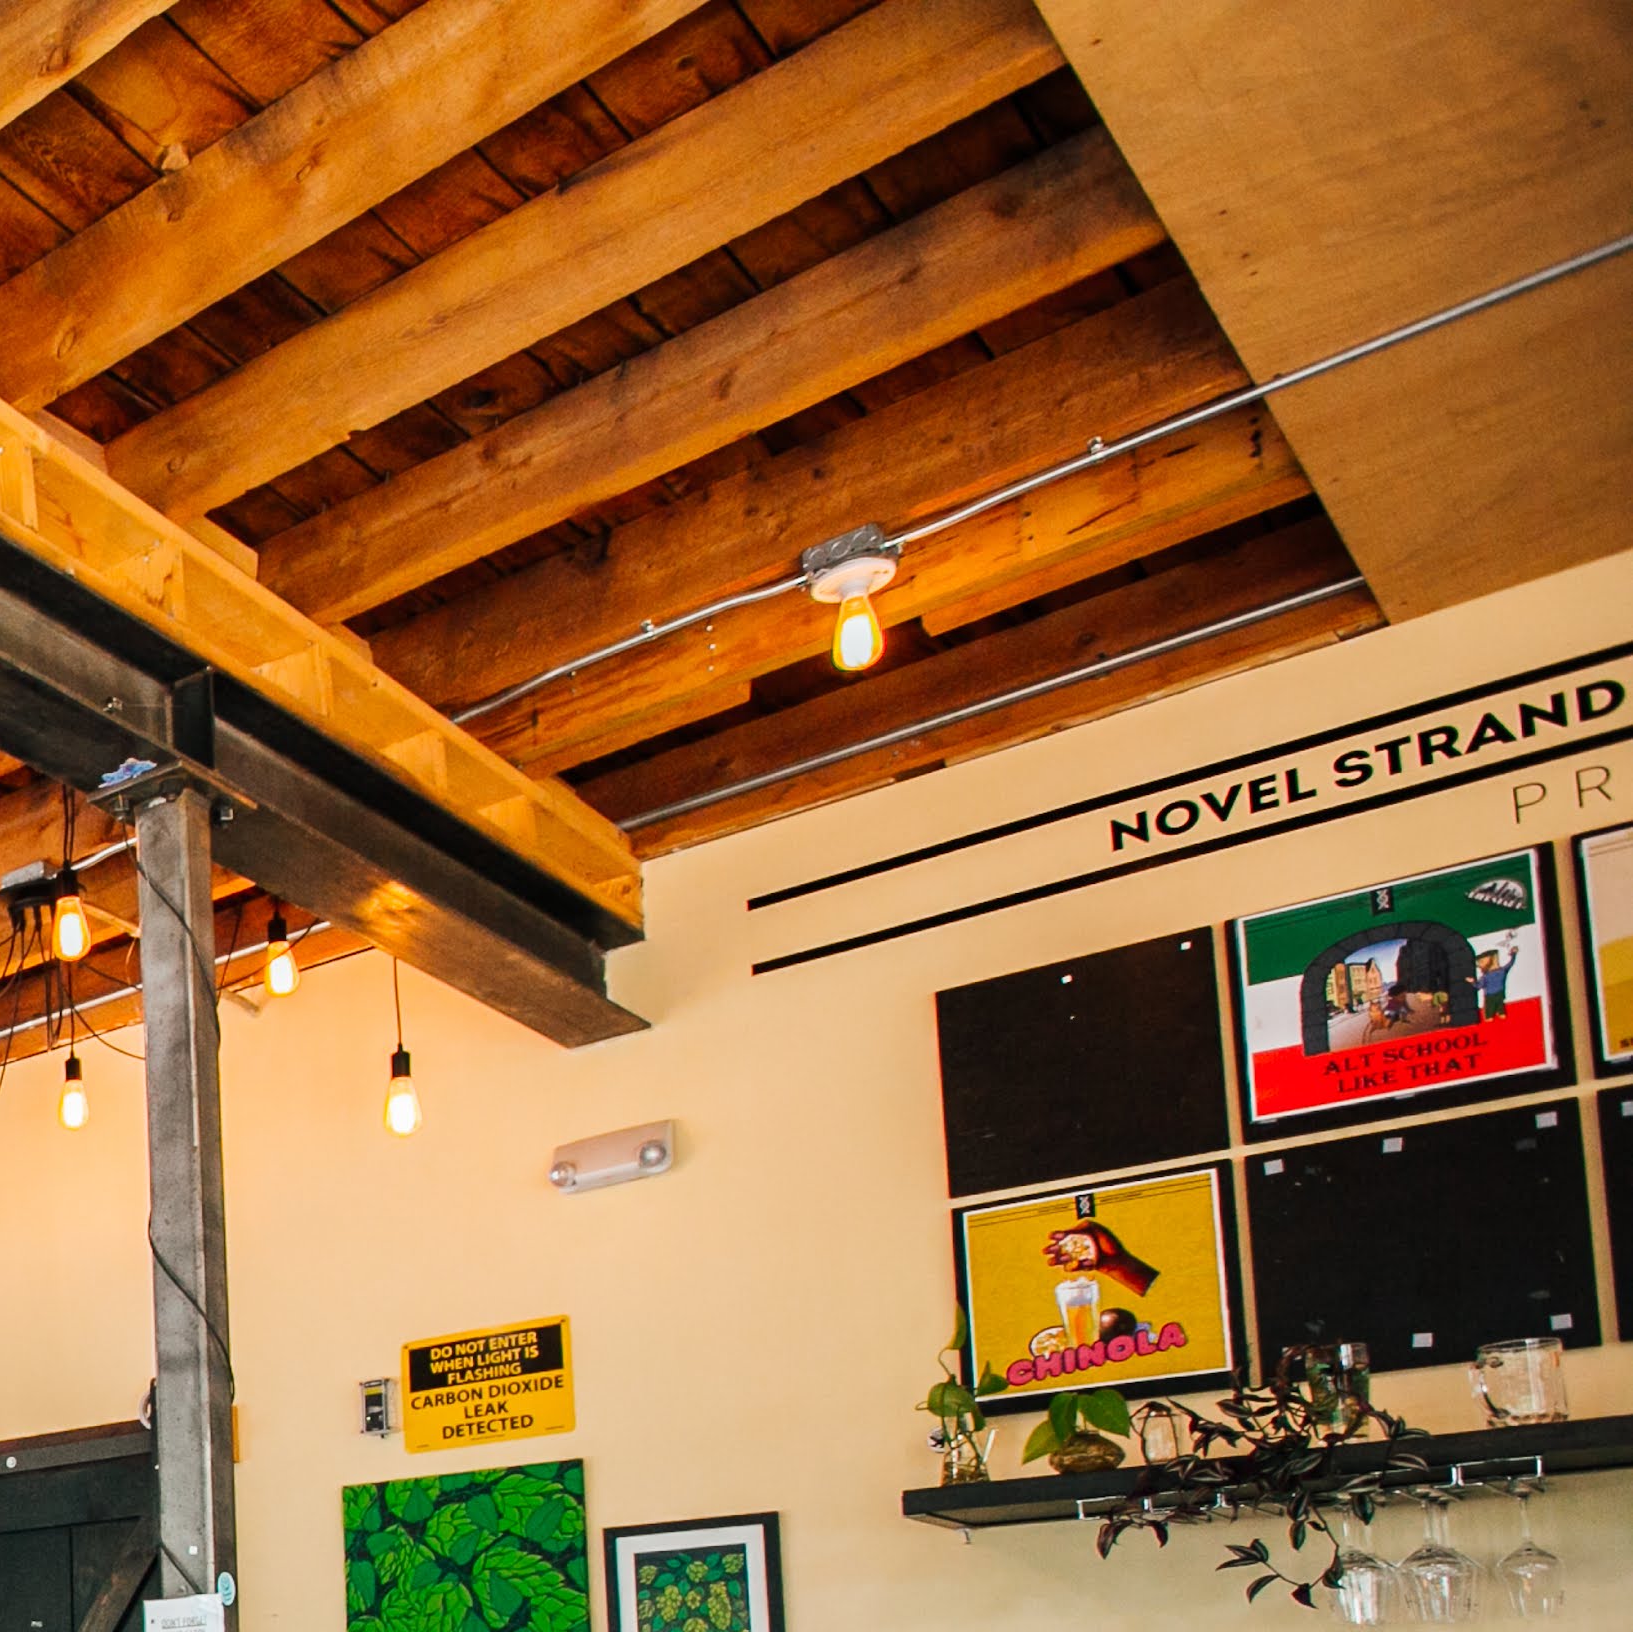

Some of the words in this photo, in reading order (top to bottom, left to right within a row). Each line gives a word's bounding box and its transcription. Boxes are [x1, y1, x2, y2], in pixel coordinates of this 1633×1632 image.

[1110, 766, 1317, 851] NOVEL
[1333, 679, 1626, 788] STRAND
[1323, 1052, 1375, 1077] ALT
[1382, 1032, 1488, 1063] SCHOOL
[1337, 1067, 1397, 1094] LIKE
[1408, 1053, 1483, 1081] THAT
[430, 1345, 453, 1361] DO
[454, 1340, 487, 1358] NOT
[489, 1331, 537, 1351] ENTER
[430, 1355, 474, 1374] WHEN
[477, 1348, 522, 1368] LIGHT
[524, 1345, 539, 1360] IS
[1005, 1321, 1187, 1386] CHINOLA
[447, 1362, 521, 1385] FLASHING
[411, 1387, 483, 1410] CARBON
[488, 1374, 564, 1398] DIOXIDE
[464, 1400, 508, 1419] LEAK
[442, 1414, 533, 1440] DETECTED
